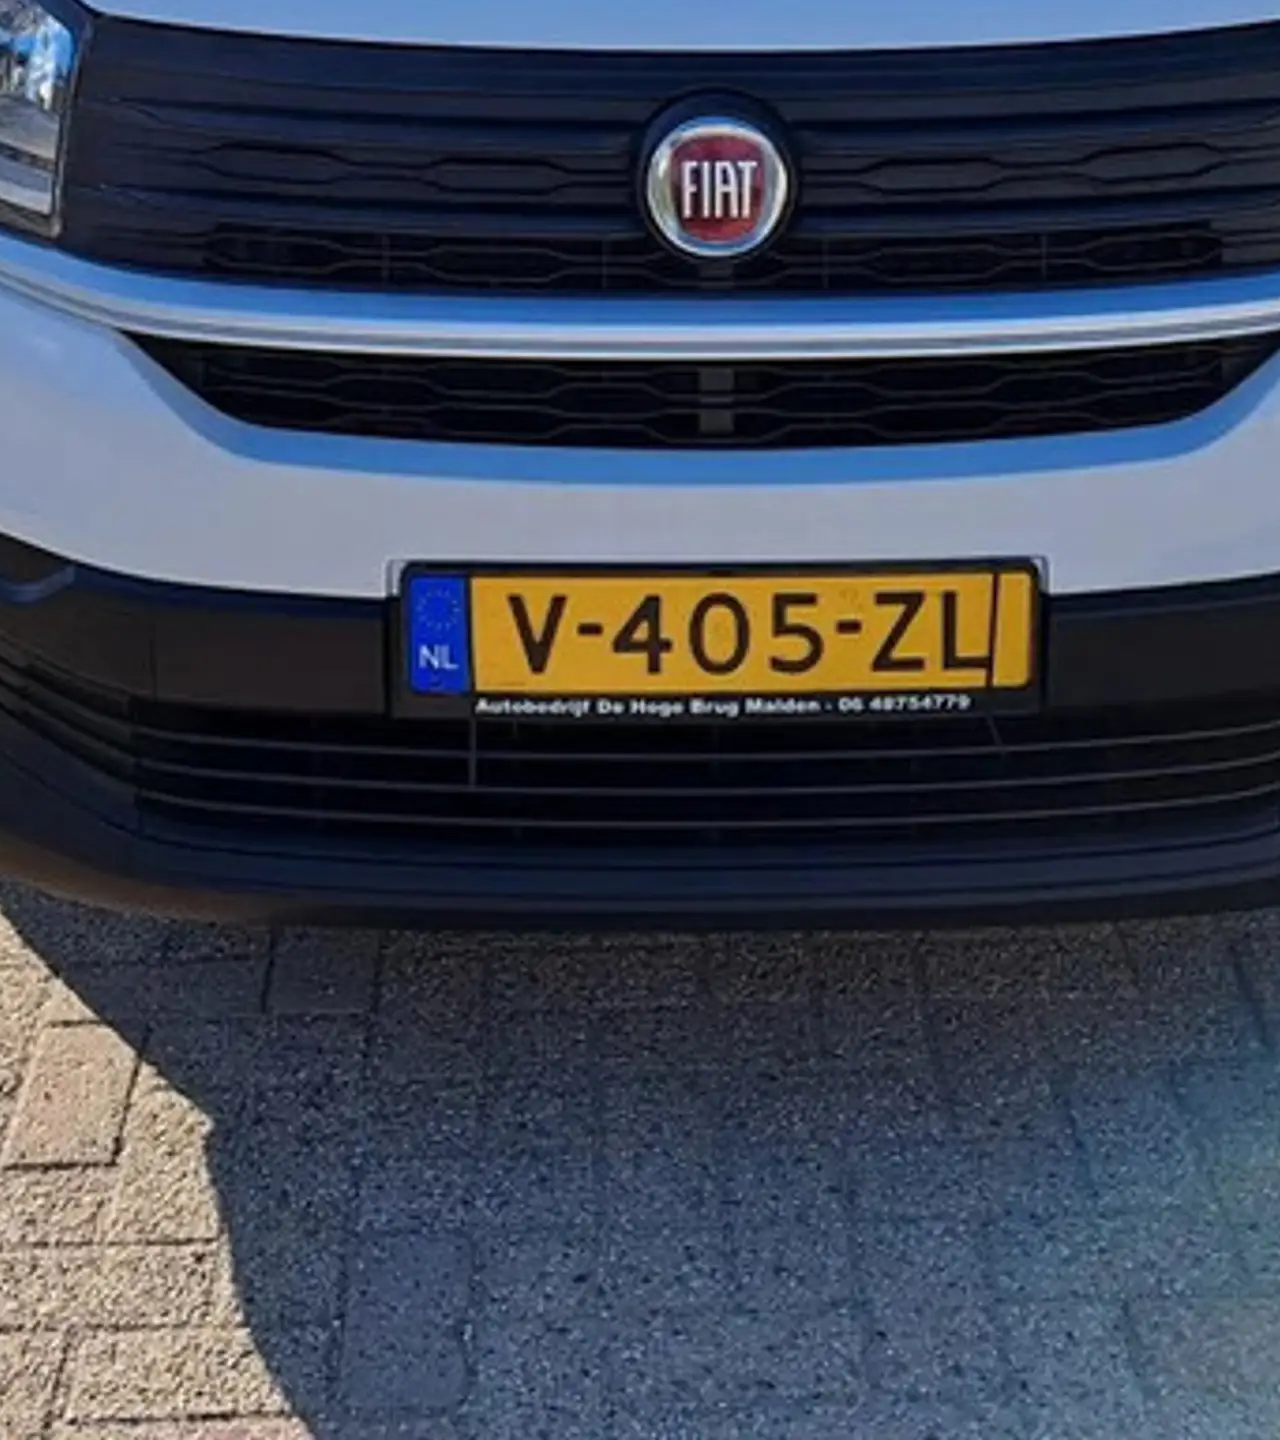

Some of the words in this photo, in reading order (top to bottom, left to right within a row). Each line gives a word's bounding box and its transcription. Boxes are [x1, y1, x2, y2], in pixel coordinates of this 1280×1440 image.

[681, 160, 757, 218] FIAT
[506, 591, 991, 675] V-405-ZL
[419, 644, 459, 670] NL
[475, 697, 590, 718] Autobedrijf
[597, 699, 624, 714] De
[690, 698, 739, 717] Brug
[745, 697, 820, 714] Malden
[838, 696, 864, 712] 06
